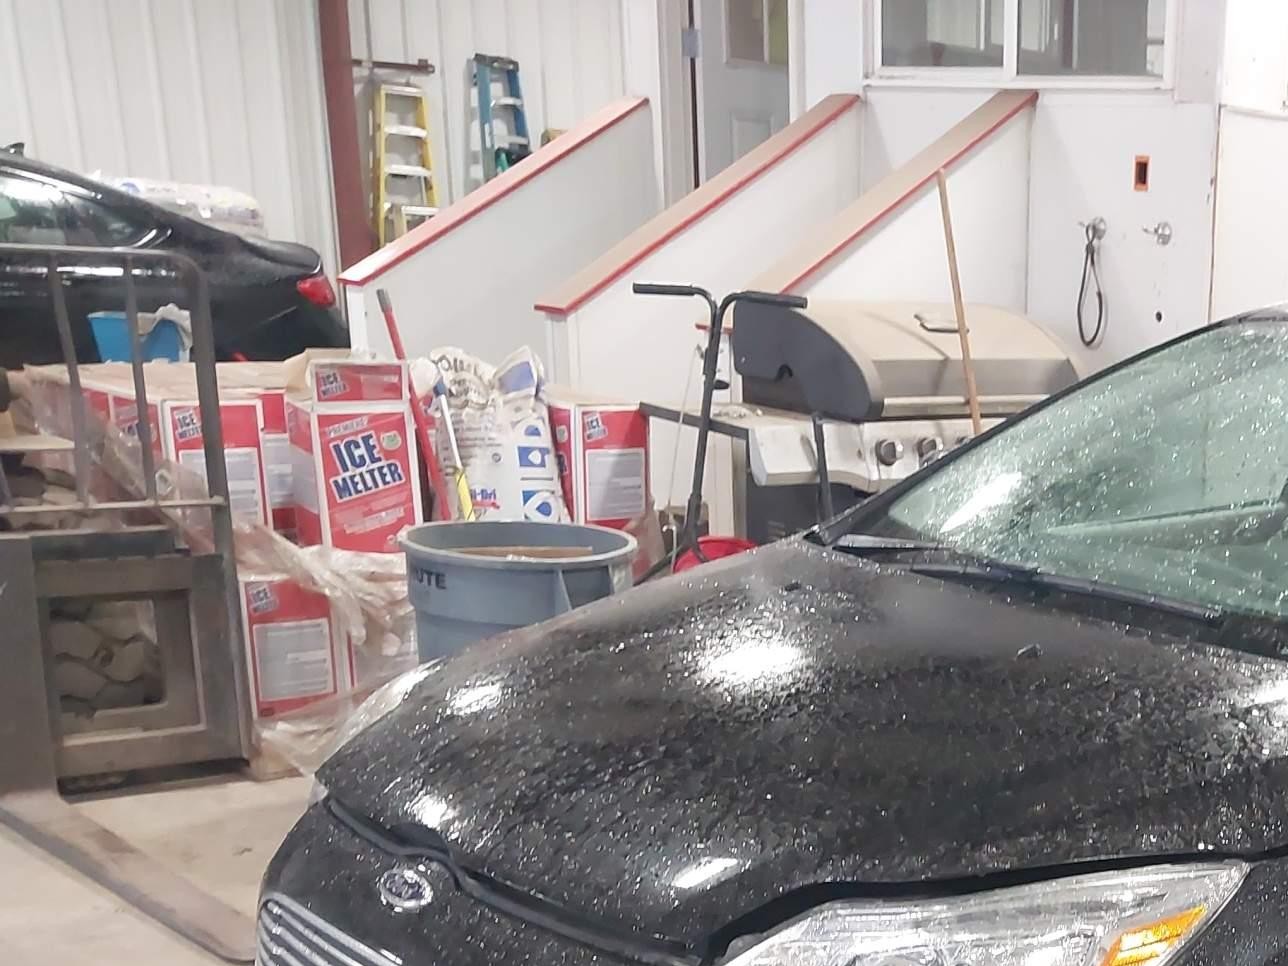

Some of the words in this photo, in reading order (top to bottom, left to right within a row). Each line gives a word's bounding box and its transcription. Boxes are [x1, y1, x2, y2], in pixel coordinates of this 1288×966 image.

[177, 413, 196, 428] ICE
[331, 432, 382, 473] ICE
[332, 461, 404, 500] MELTER
[415, 567, 447, 590] UTE
